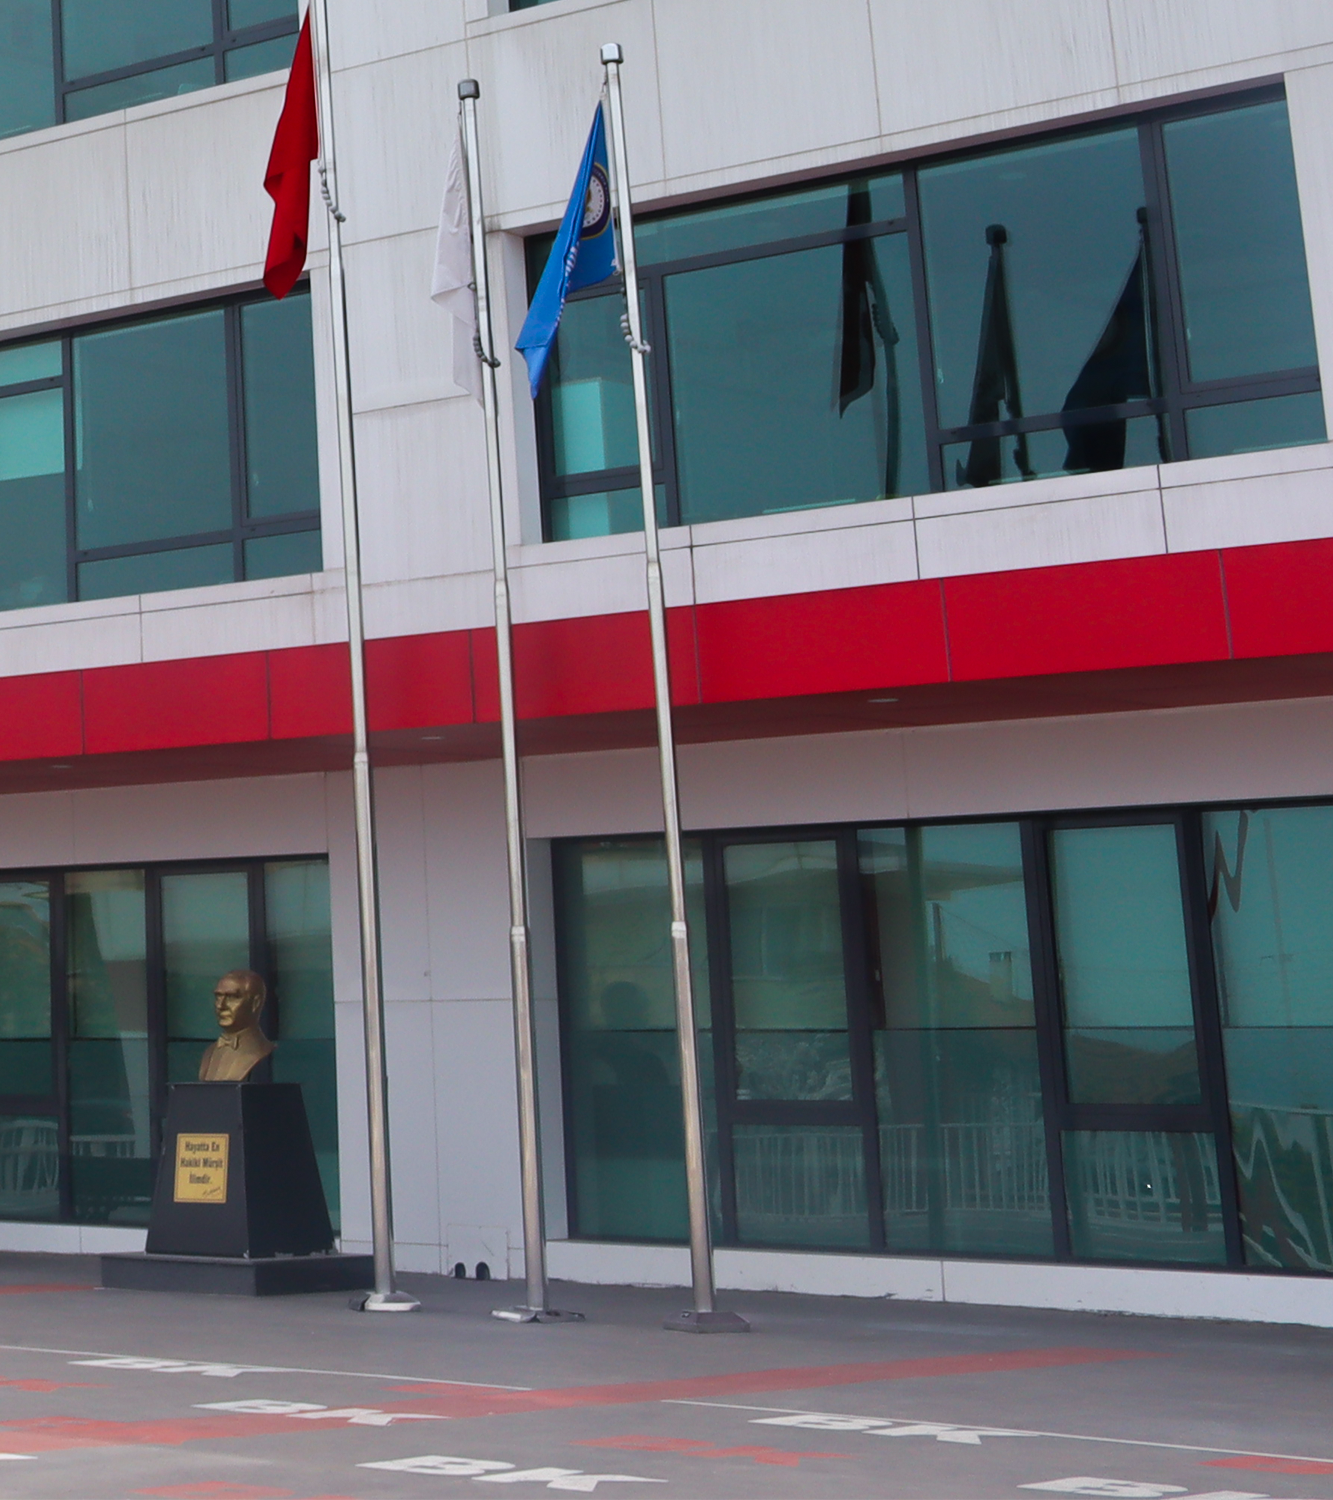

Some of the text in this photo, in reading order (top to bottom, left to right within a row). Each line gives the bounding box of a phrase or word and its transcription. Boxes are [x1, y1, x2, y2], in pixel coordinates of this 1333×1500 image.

[185, 1141, 220, 1154] Hayatta En
[180, 1157, 223, 1171] Hakiki Mürşit
[190, 1399, 453, 1426] BK
[747, 1414, 1033, 1446] BK
[355, 1455, 669, 1492] BK
